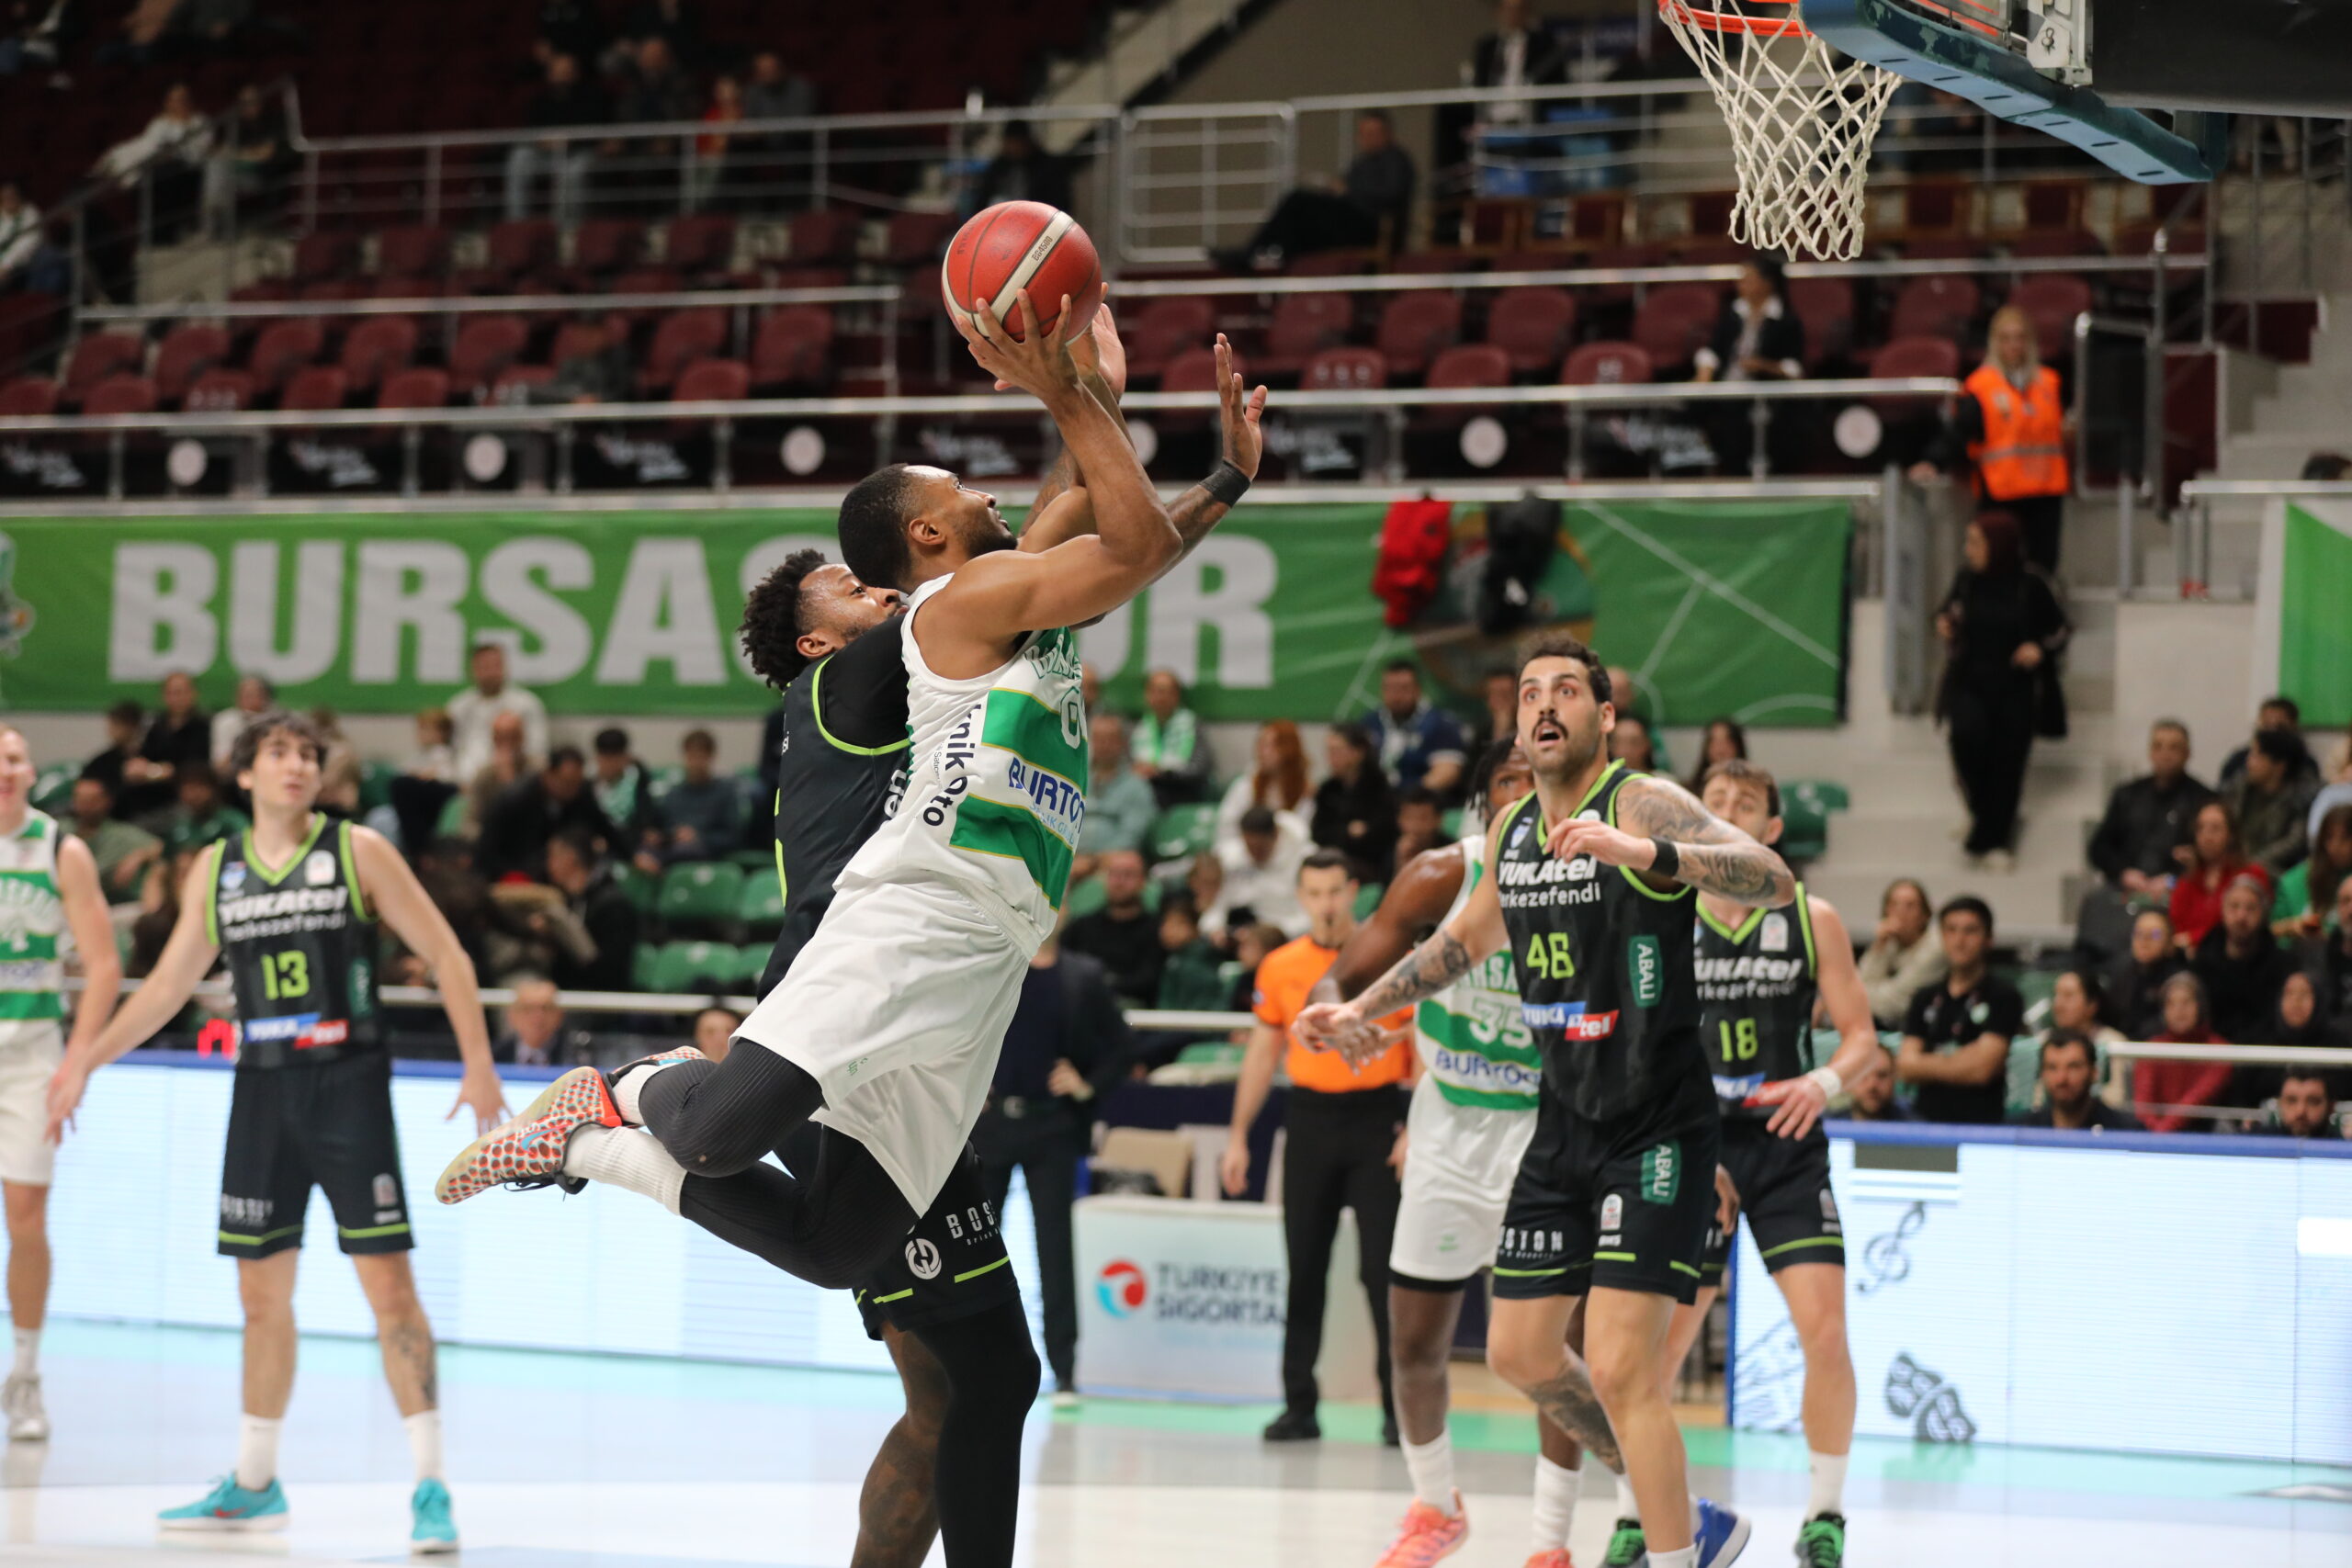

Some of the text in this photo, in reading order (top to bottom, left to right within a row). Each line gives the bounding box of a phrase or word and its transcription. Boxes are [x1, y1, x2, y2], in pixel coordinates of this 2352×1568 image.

[108, 535, 1275, 687] BURSAR
[261, 950, 310, 1000] 13
[1526, 932, 1575, 979] 46
[1637, 943, 1655, 999] ABALI
[1694, 956, 1804, 981] UKAtel
[1469, 996, 1533, 1049] 35
[1719, 1018, 1758, 1062] 18
[945, 1199, 996, 1239] BOS
